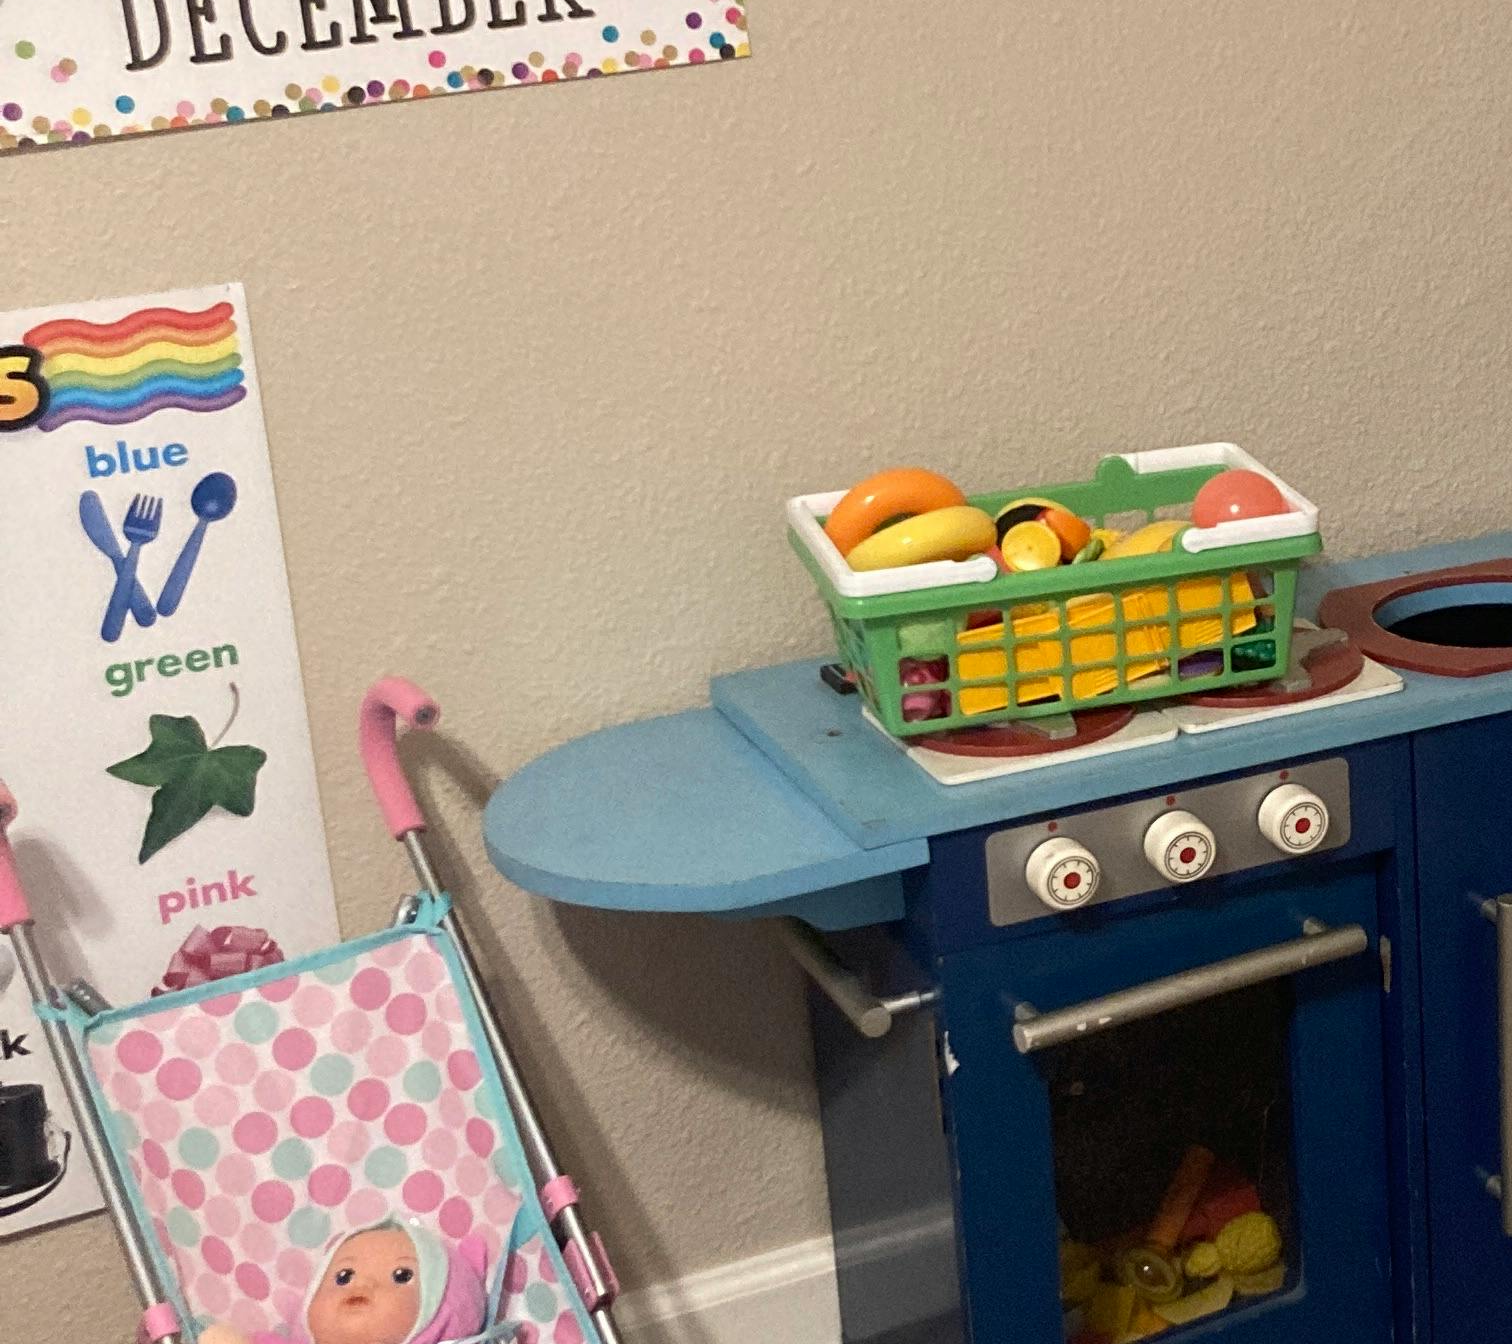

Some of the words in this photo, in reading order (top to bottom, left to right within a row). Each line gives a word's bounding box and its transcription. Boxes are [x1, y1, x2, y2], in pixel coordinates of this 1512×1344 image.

[85, 440, 189, 478] blue
[105, 643, 239, 698] green
[159, 869, 257, 925] pink
